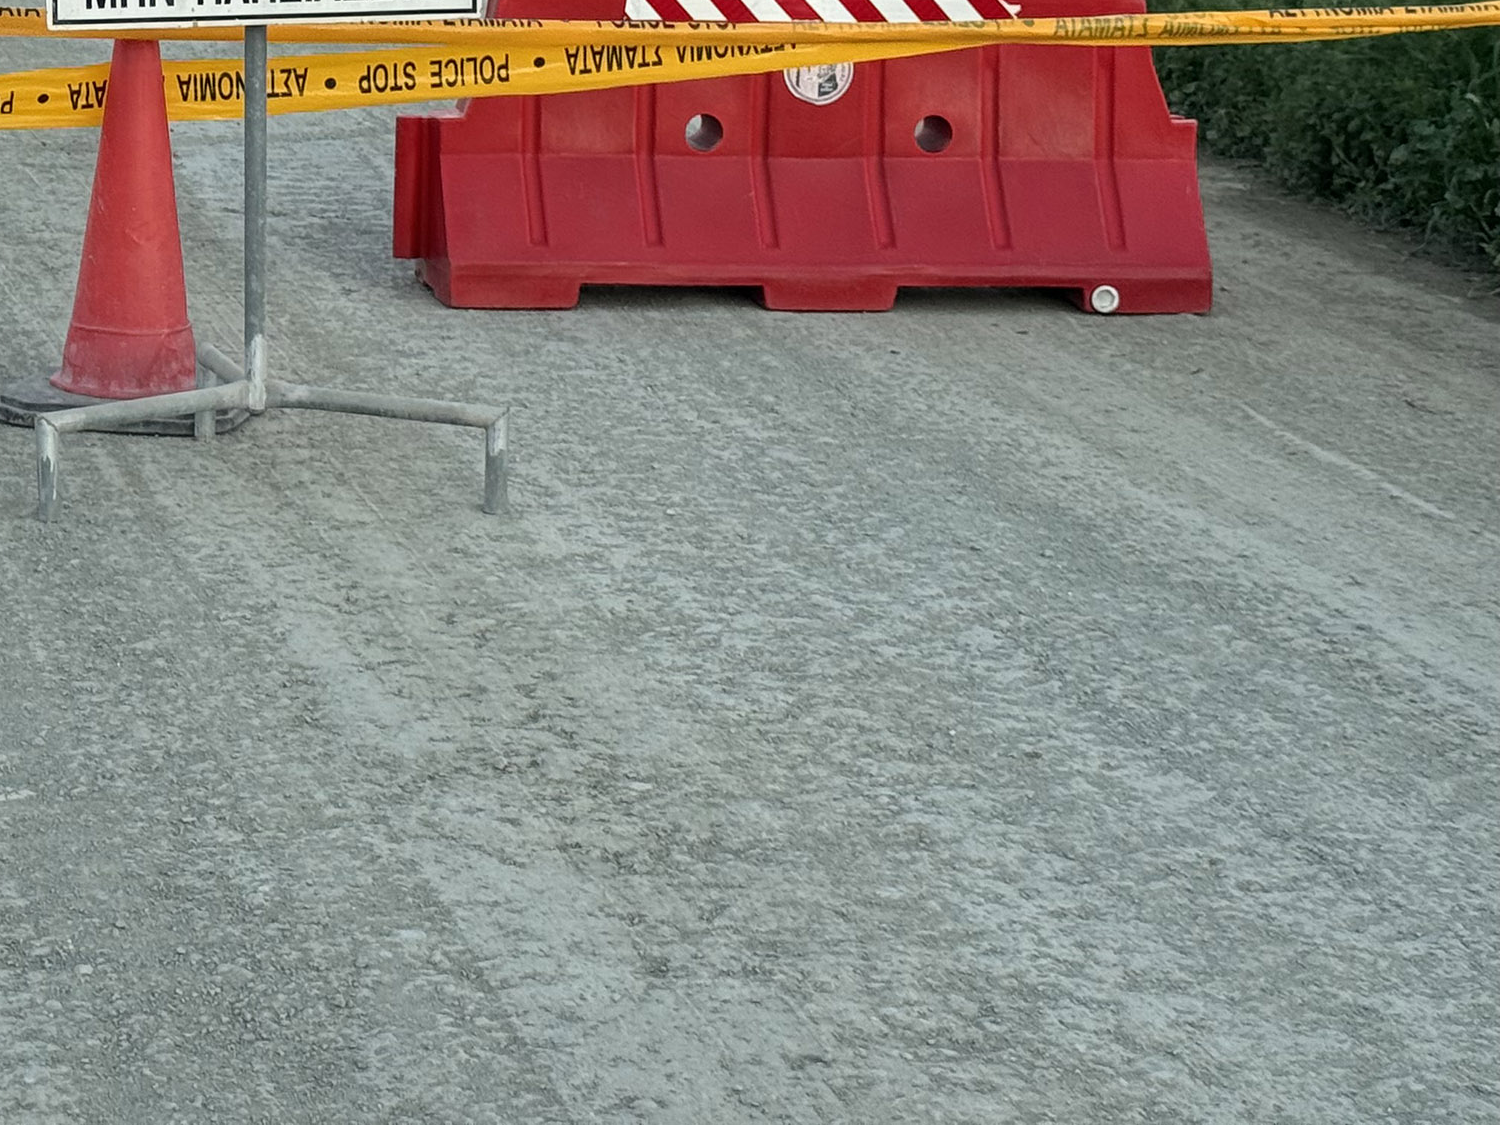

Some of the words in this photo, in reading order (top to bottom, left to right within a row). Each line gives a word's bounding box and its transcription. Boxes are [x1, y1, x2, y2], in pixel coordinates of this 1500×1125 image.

[176, 67, 309, 103] ΑΣΤΝΟΜΙΑ
[358, 60, 418, 95] STOP
[429, 53, 510, 89] POLICE
